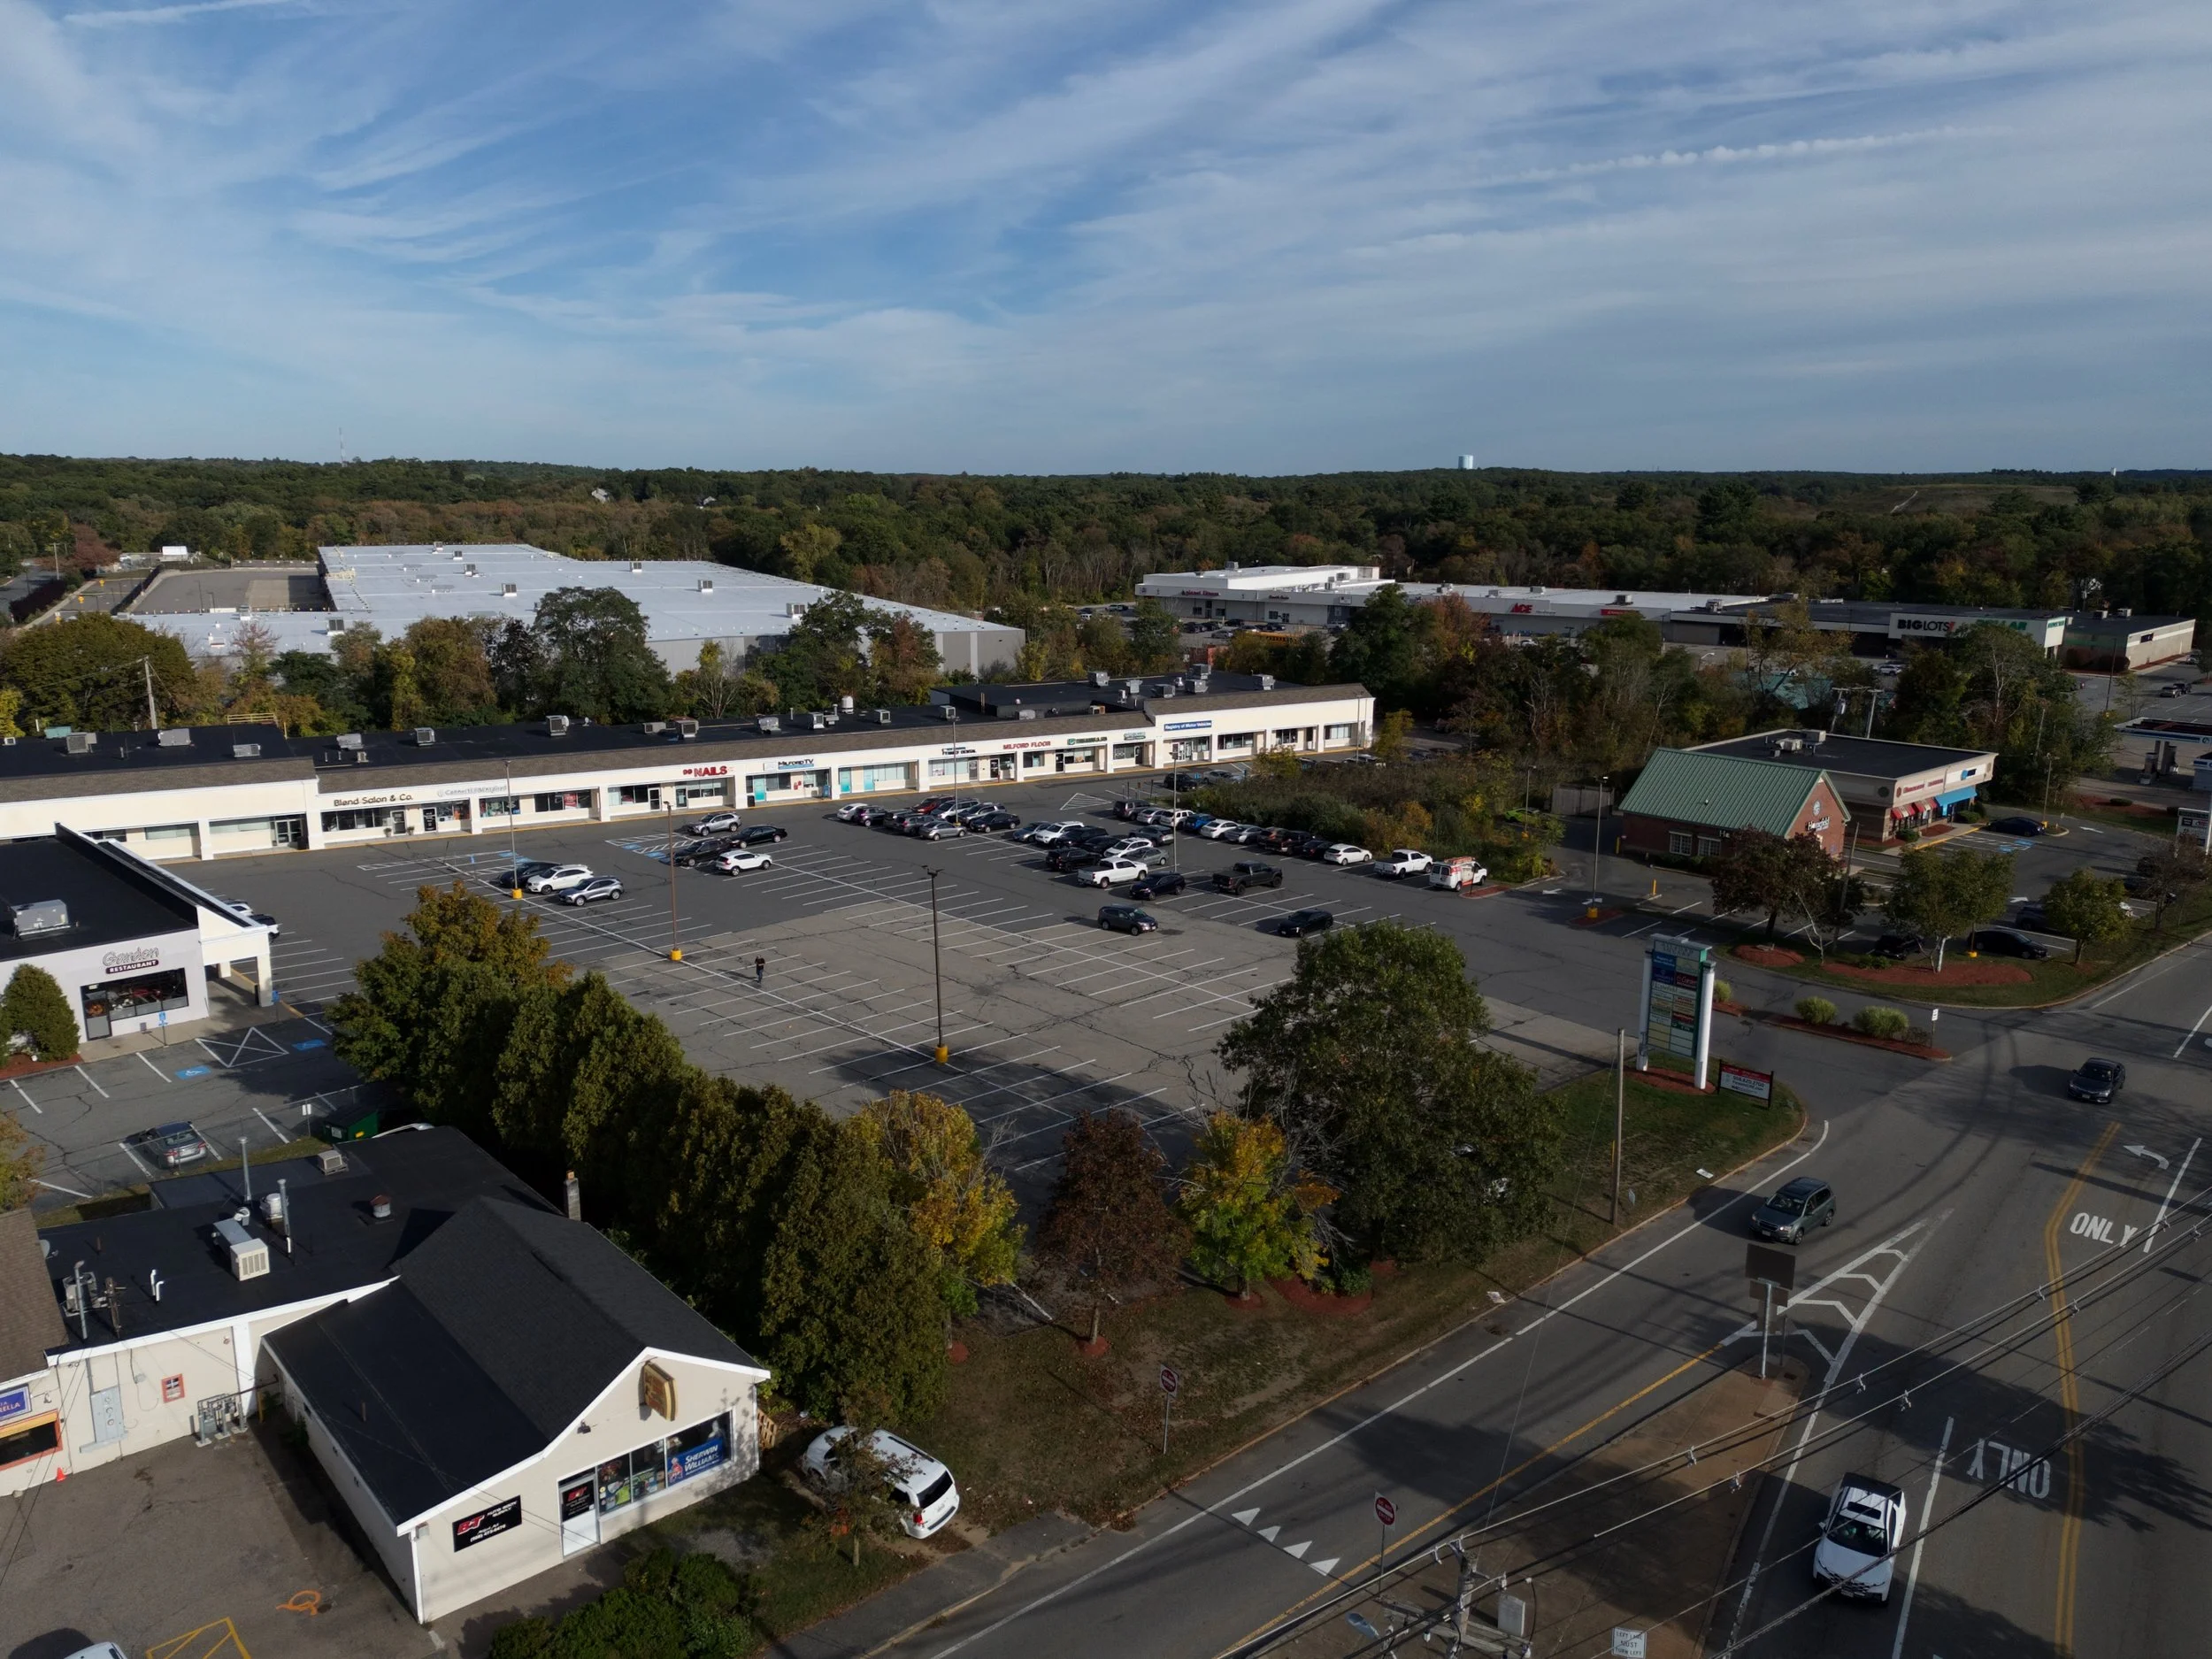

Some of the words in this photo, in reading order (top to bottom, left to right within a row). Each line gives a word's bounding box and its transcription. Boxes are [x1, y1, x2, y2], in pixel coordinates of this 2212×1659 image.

[1509, 603, 1533, 614] ACE
[1897, 619, 1923, 630] BIG
[694, 765, 728, 777] NAILS
[334, 798, 359, 807] Blend
[109, 960, 157, 972] RESTAURANT
[2070, 1212, 2139, 1248] ONLY
[685, 1445, 718, 1464] SHERWIN
[1966, 1439, 2051, 1499] ONLY
